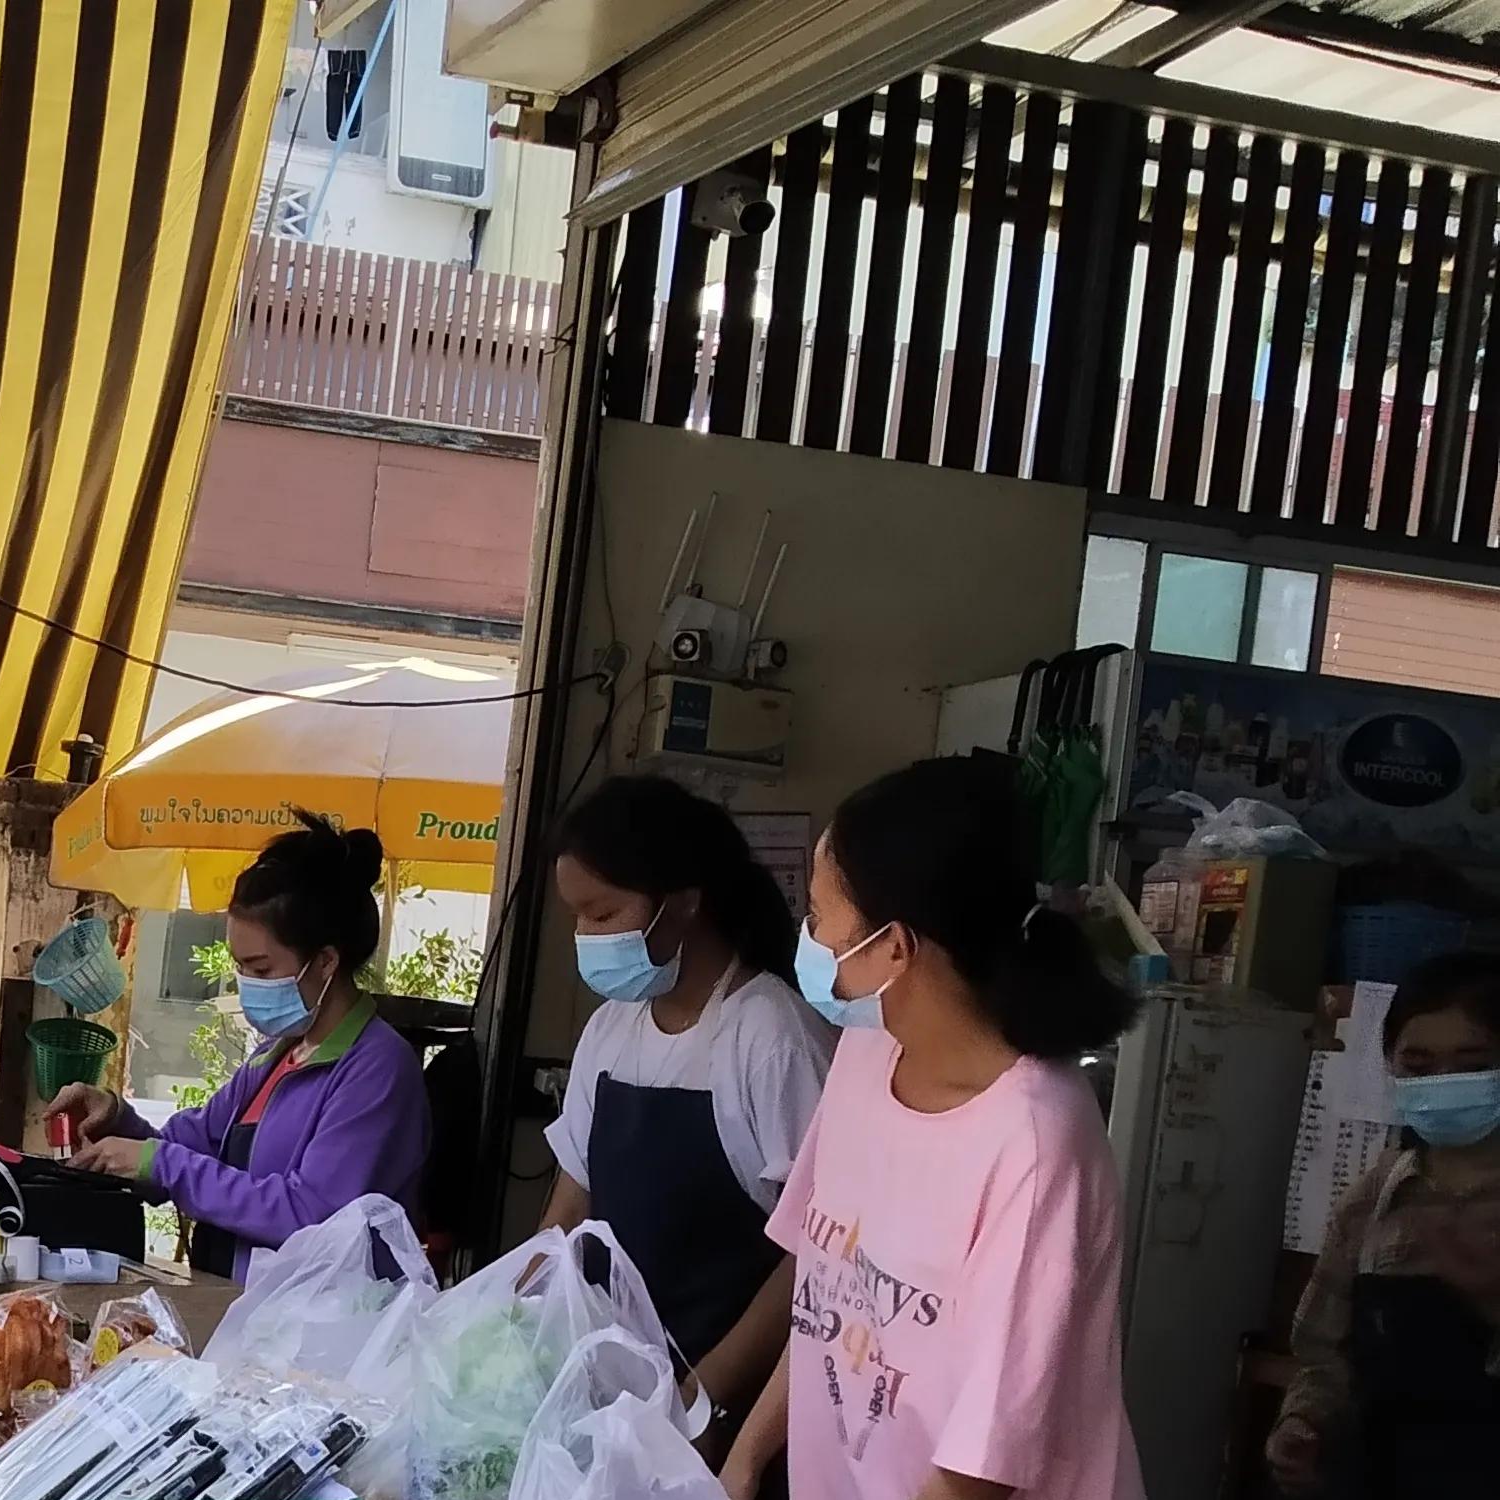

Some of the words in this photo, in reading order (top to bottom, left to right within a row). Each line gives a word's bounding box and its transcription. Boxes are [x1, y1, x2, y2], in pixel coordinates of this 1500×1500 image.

[1353, 761, 1445, 786] INTERCOOL
[416, 811, 501, 841] Proud
[791, 1315, 817, 1339] PEN
[824, 1355, 843, 1406] OPEN
[866, 1375, 887, 1423] OPEN
